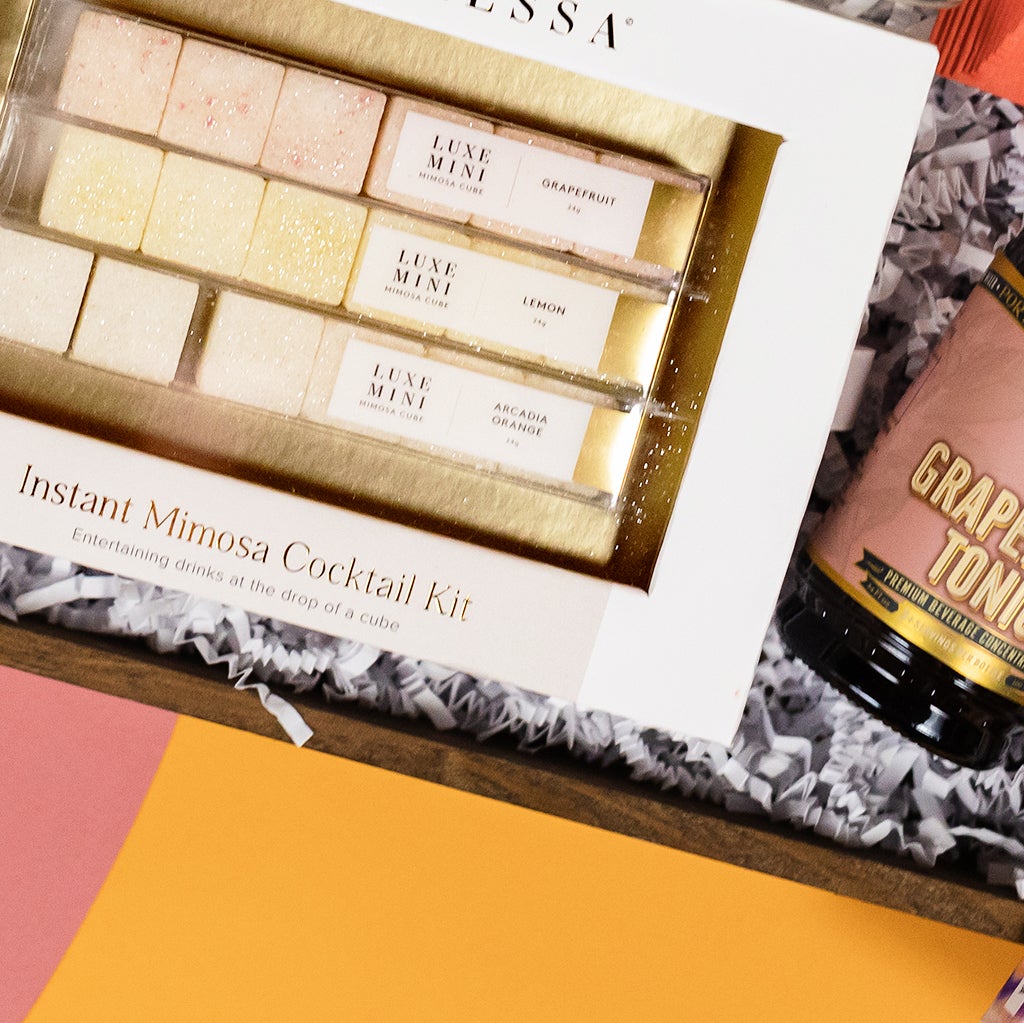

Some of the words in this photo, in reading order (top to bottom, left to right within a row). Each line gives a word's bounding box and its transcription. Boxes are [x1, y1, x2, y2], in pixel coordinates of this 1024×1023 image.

[432, 135, 492, 165] LUXE
[427, 154, 485, 182] MINI
[418, 171, 456, 188] MIMOSA
[459, 182, 484, 195] CUBE
[541, 177, 617, 207] GRAPEFRUIT
[398, 249, 458, 279] LUXE
[392, 268, 451, 296] MINI
[384, 285, 422, 302] MIMOSA
[424, 296, 449, 309] CUBE
[522, 295, 567, 317] LEMON
[373, 363, 433, 393] LUXE
[359, 399, 396, 417] MIMOSA
[367, 382, 426, 410] MINI
[491, 415, 544, 438] ORANGE
[494, 402, 548, 425] ARCADIA
[911, 441, 1024, 566] GRAPE
[17, 463, 135, 524] Instant
[142, 499, 270, 564] Mimosa
[282, 541, 416, 606] Cocktail
[426, 581, 475, 622] Kit
[72, 526, 171, 570] Entertaining
[174, 554, 225, 583] drinks
[228, 570, 247, 588] at
[249, 575, 277, 597] the
[280, 585, 321, 612] drop
[323, 599, 343, 616] of
[345, 607, 355, 619] a
[362, 612, 401, 633] cube
[884, 569, 927, 608] PREMIUM
[928, 598, 977, 640] BEVERAGE
